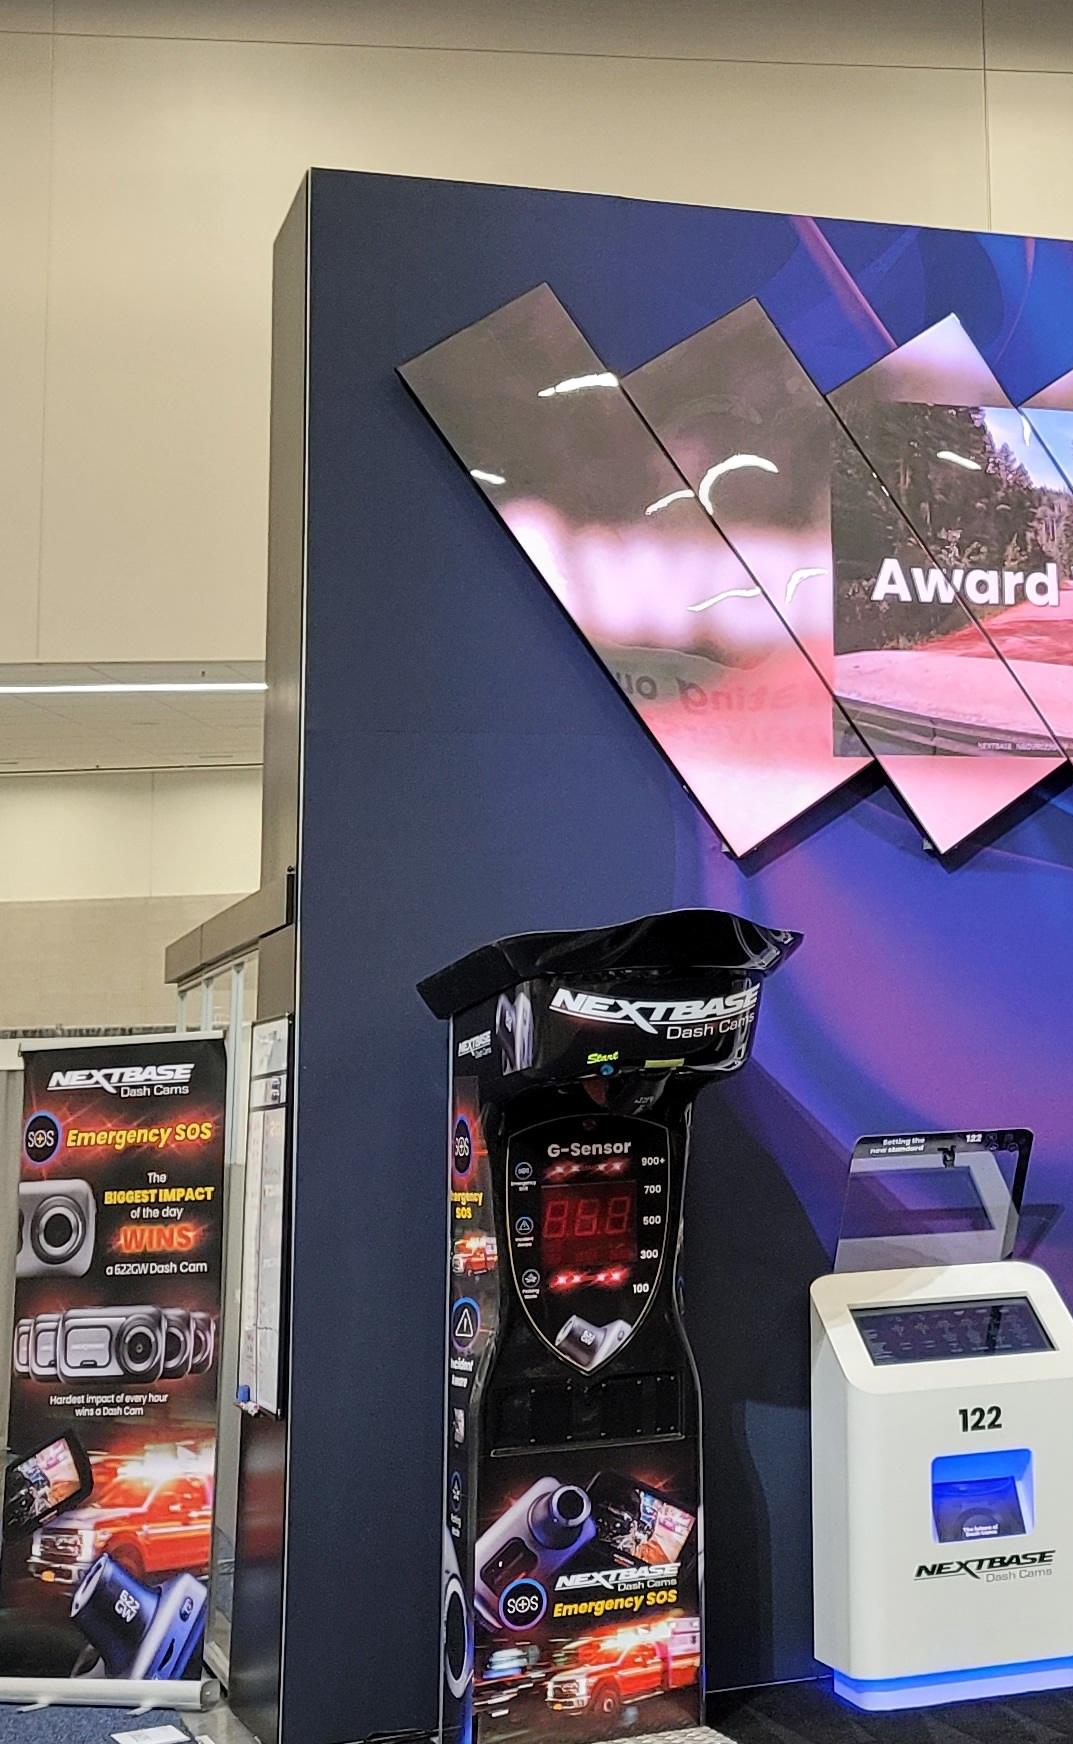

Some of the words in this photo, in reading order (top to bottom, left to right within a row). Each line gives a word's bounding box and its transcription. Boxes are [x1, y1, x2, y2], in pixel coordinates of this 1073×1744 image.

[870, 558, 1059, 607] Award
[549, 982, 760, 1034] NEXTBASE
[667, 1024, 713, 1039] Dash
[719, 1013, 755, 1033] Cams
[587, 1051, 619, 1064] Start
[47, 1064, 195, 1094] NEXTBASE
[121, 1086, 150, 1098] Dash
[153, 1085, 190, 1096] Cams
[66, 1127, 173, 1150] Emergency
[175, 1122, 212, 1140] SOS
[966, 1134, 982, 1143] 122
[547, 1141, 632, 1158] G-Sensor
[641, 1156, 665, 1167] 900+
[147, 1172, 167, 1184] The
[104, 1189, 157, 1204] BIGGEST
[159, 1187, 215, 1202] IMPACT
[644, 1185, 661, 1194] 700
[130, 1207, 141, 1219] of
[143, 1206, 159, 1218] the
[161, 1206, 184, 1220] day
[456, 1207, 472, 1219] SOS
[643, 1216, 661, 1226] 500
[122, 1223, 193, 1252] WINS
[640, 1249, 658, 1260] 300
[106, 1266, 113, 1276] a
[115, 1263, 148, 1275] 622GW
[150, 1262, 177, 1274] Dash
[179, 1262, 208, 1273] Cam
[633, 1283, 649, 1294] 100
[49, 1395, 85, 1405] Hardest
[86, 1394, 115, 1406] impact
[115, 1393, 124, 1403] of
[125, 1394, 148, 1405] every
[148, 1393, 168, 1403] hour
[75, 1407, 94, 1417] wins
[103, 1406, 122, 1416] Dash
[123, 1406, 144, 1416] Cam
[959, 1406, 1002, 1432] 122
[914, 1550, 1056, 1580] NEXTBASE
[554, 1562, 681, 1591] NEXTBASE
[986, 1571, 1016, 1583] Dash
[1019, 1567, 1052, 1579] Cams
[617, 1583, 645, 1592] Dash
[647, 1579, 677, 1589] Cams
[553, 1595, 644, 1617] Emergency
[646, 1589, 678, 1606] SOS
